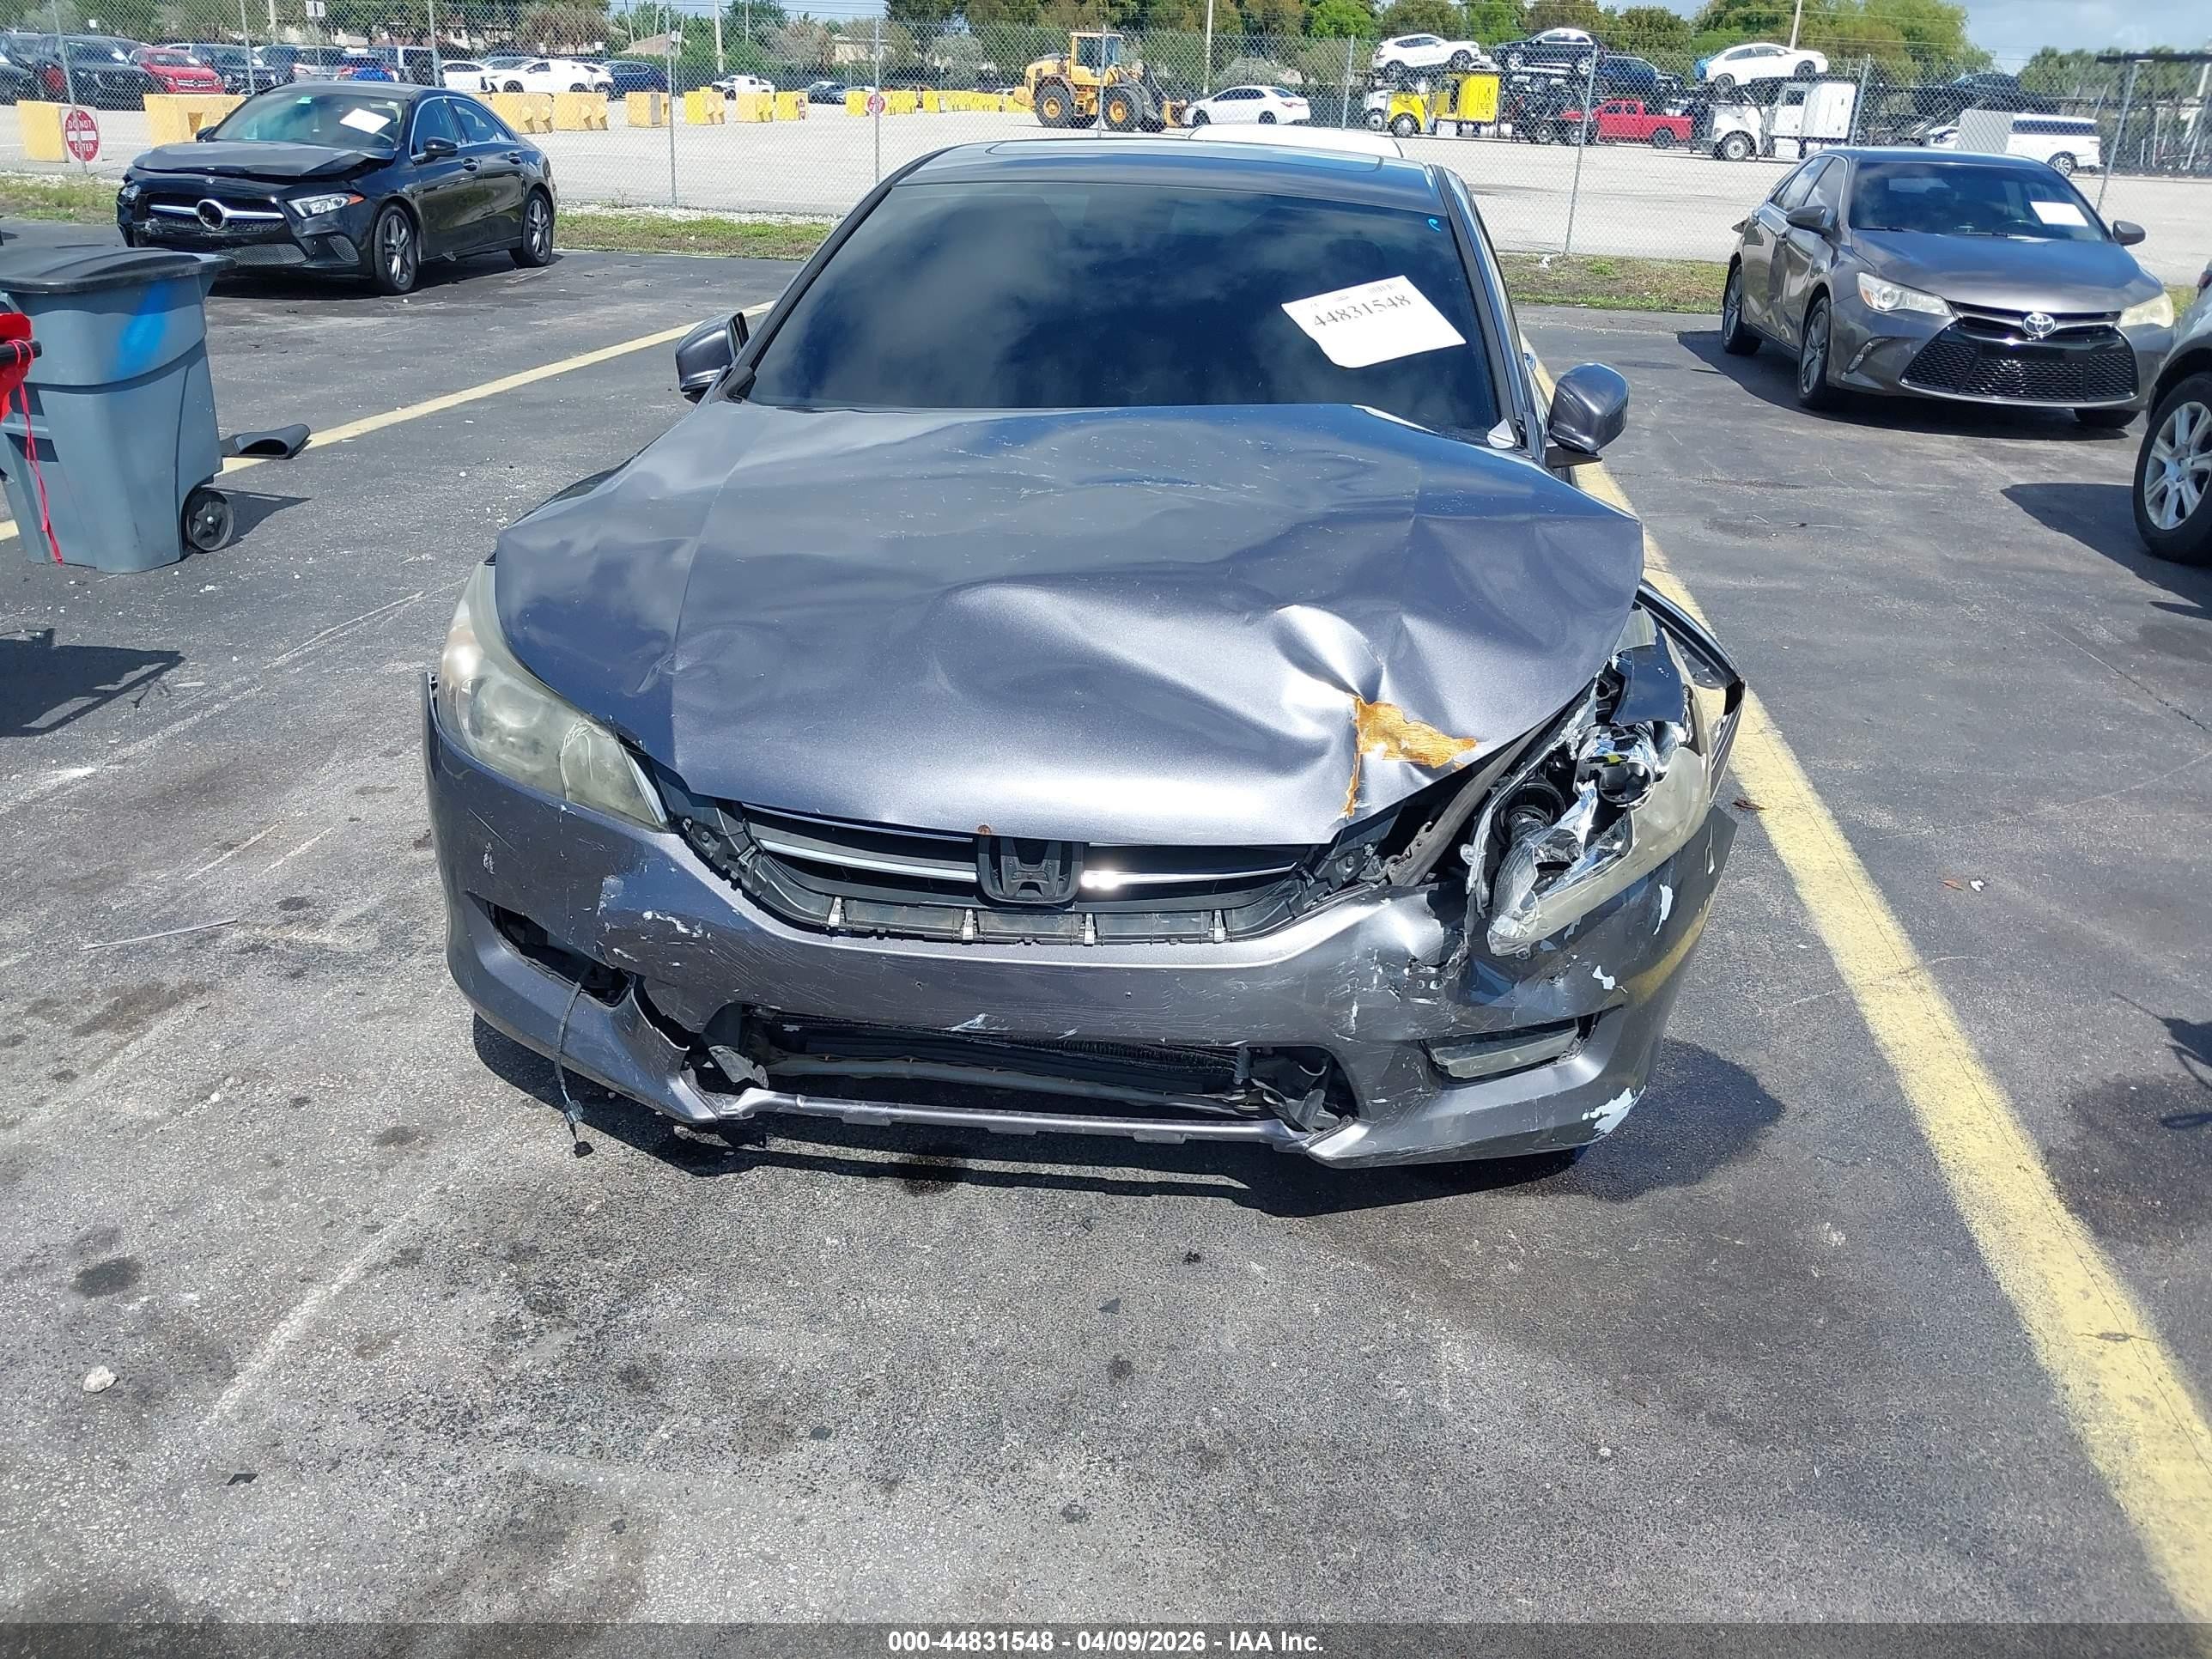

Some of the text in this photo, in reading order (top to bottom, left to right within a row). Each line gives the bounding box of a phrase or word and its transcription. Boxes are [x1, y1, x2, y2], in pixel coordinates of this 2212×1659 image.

[79, 119, 92, 130] NOT
[75, 143, 94, 152] ETER
[1314, 294, 1412, 326] 44831548
